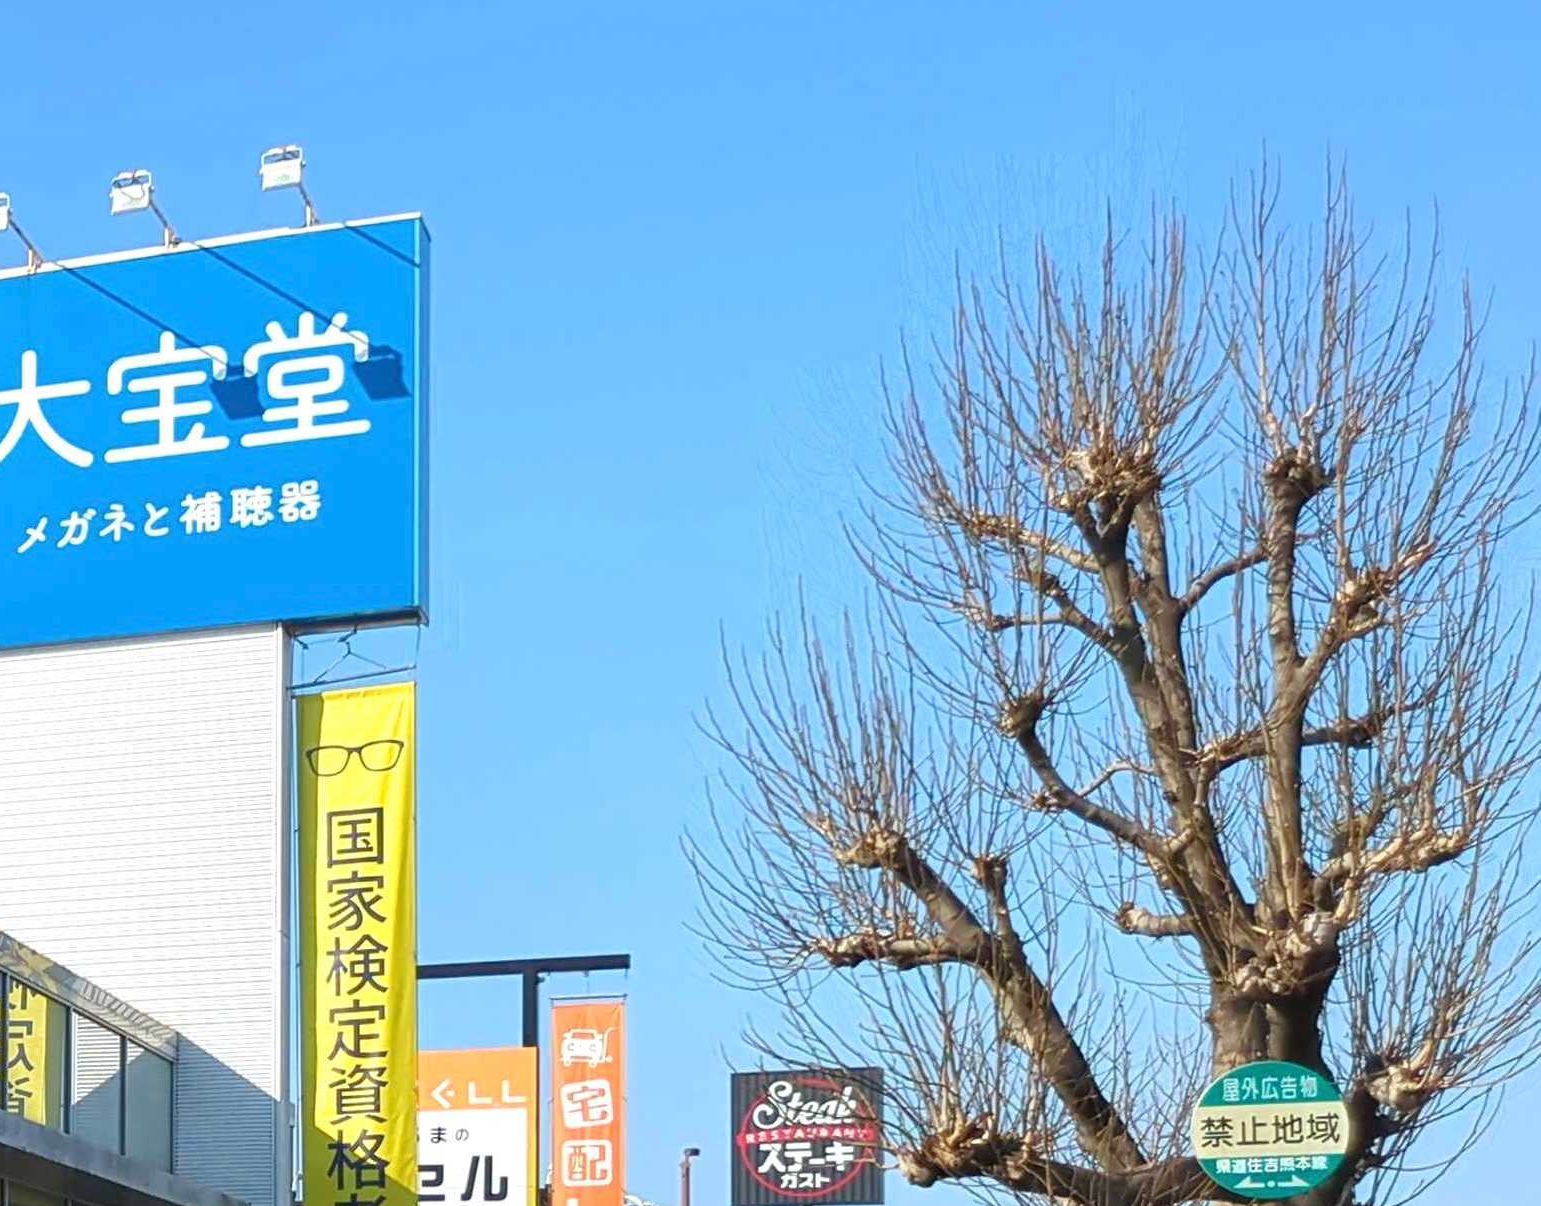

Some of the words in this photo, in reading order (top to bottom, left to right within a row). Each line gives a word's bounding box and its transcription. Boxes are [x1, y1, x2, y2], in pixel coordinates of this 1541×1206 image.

[17, 480, 322, 555] メガネと補聴器
[1222, 1075, 1318, 1102] 屋外広告物
[417, 1125, 470, 1144] まの
[1201, 1113, 1341, 1149] 禁止地域
[758, 1141, 855, 1173] ステーキ
[780, 1173, 831, 1189] ガスト
